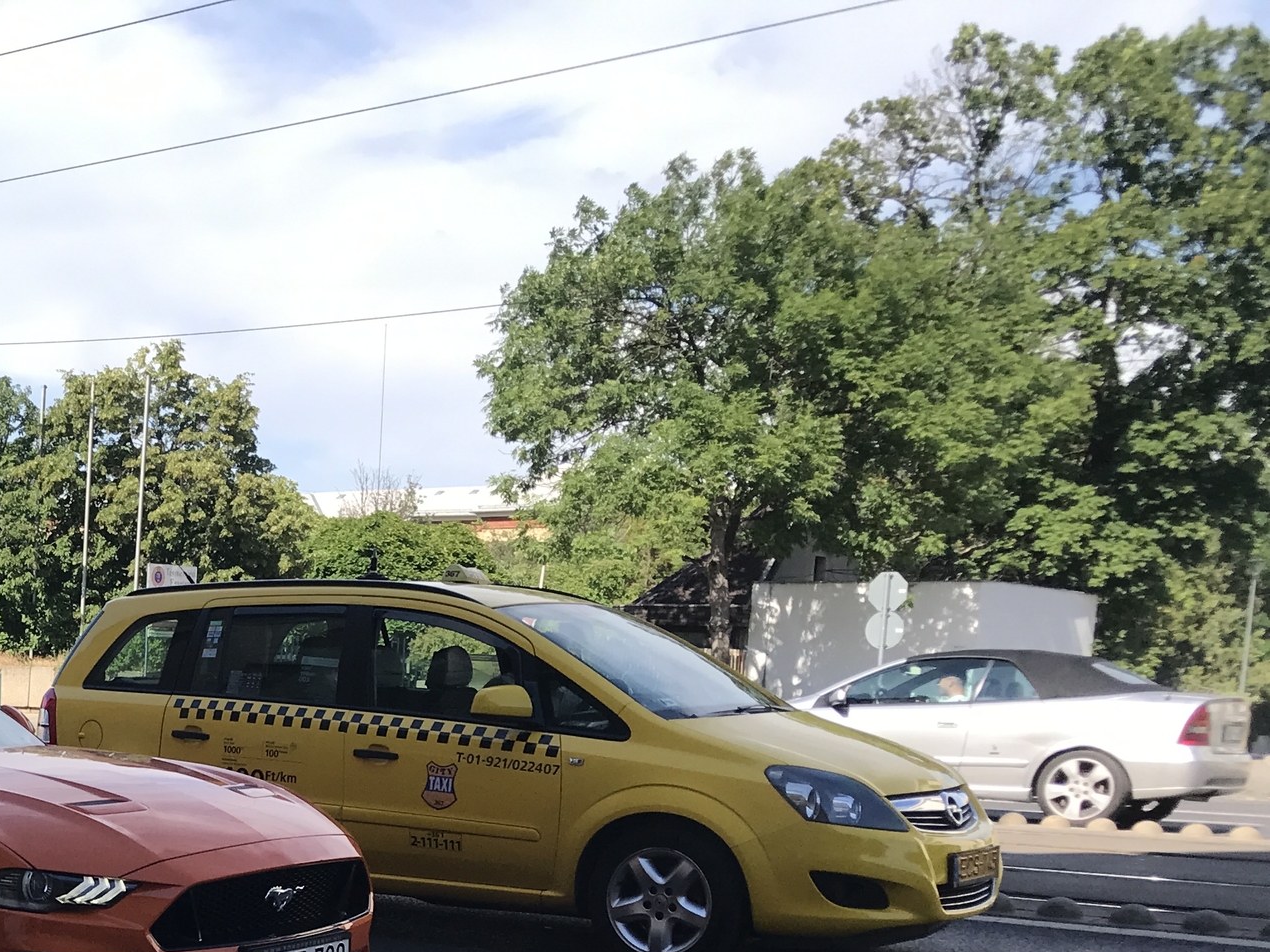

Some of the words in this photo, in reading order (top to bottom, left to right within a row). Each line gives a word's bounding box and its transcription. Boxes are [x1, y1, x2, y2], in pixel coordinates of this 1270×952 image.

[223, 745, 242, 754] 1000
[265, 749, 279, 758] 100
[429, 765, 454, 776] CITY
[456, 752, 561, 776] T-01-921/022407
[429, 776, 454, 793] TAXI
[410, 835, 462, 852] 2-111-111
